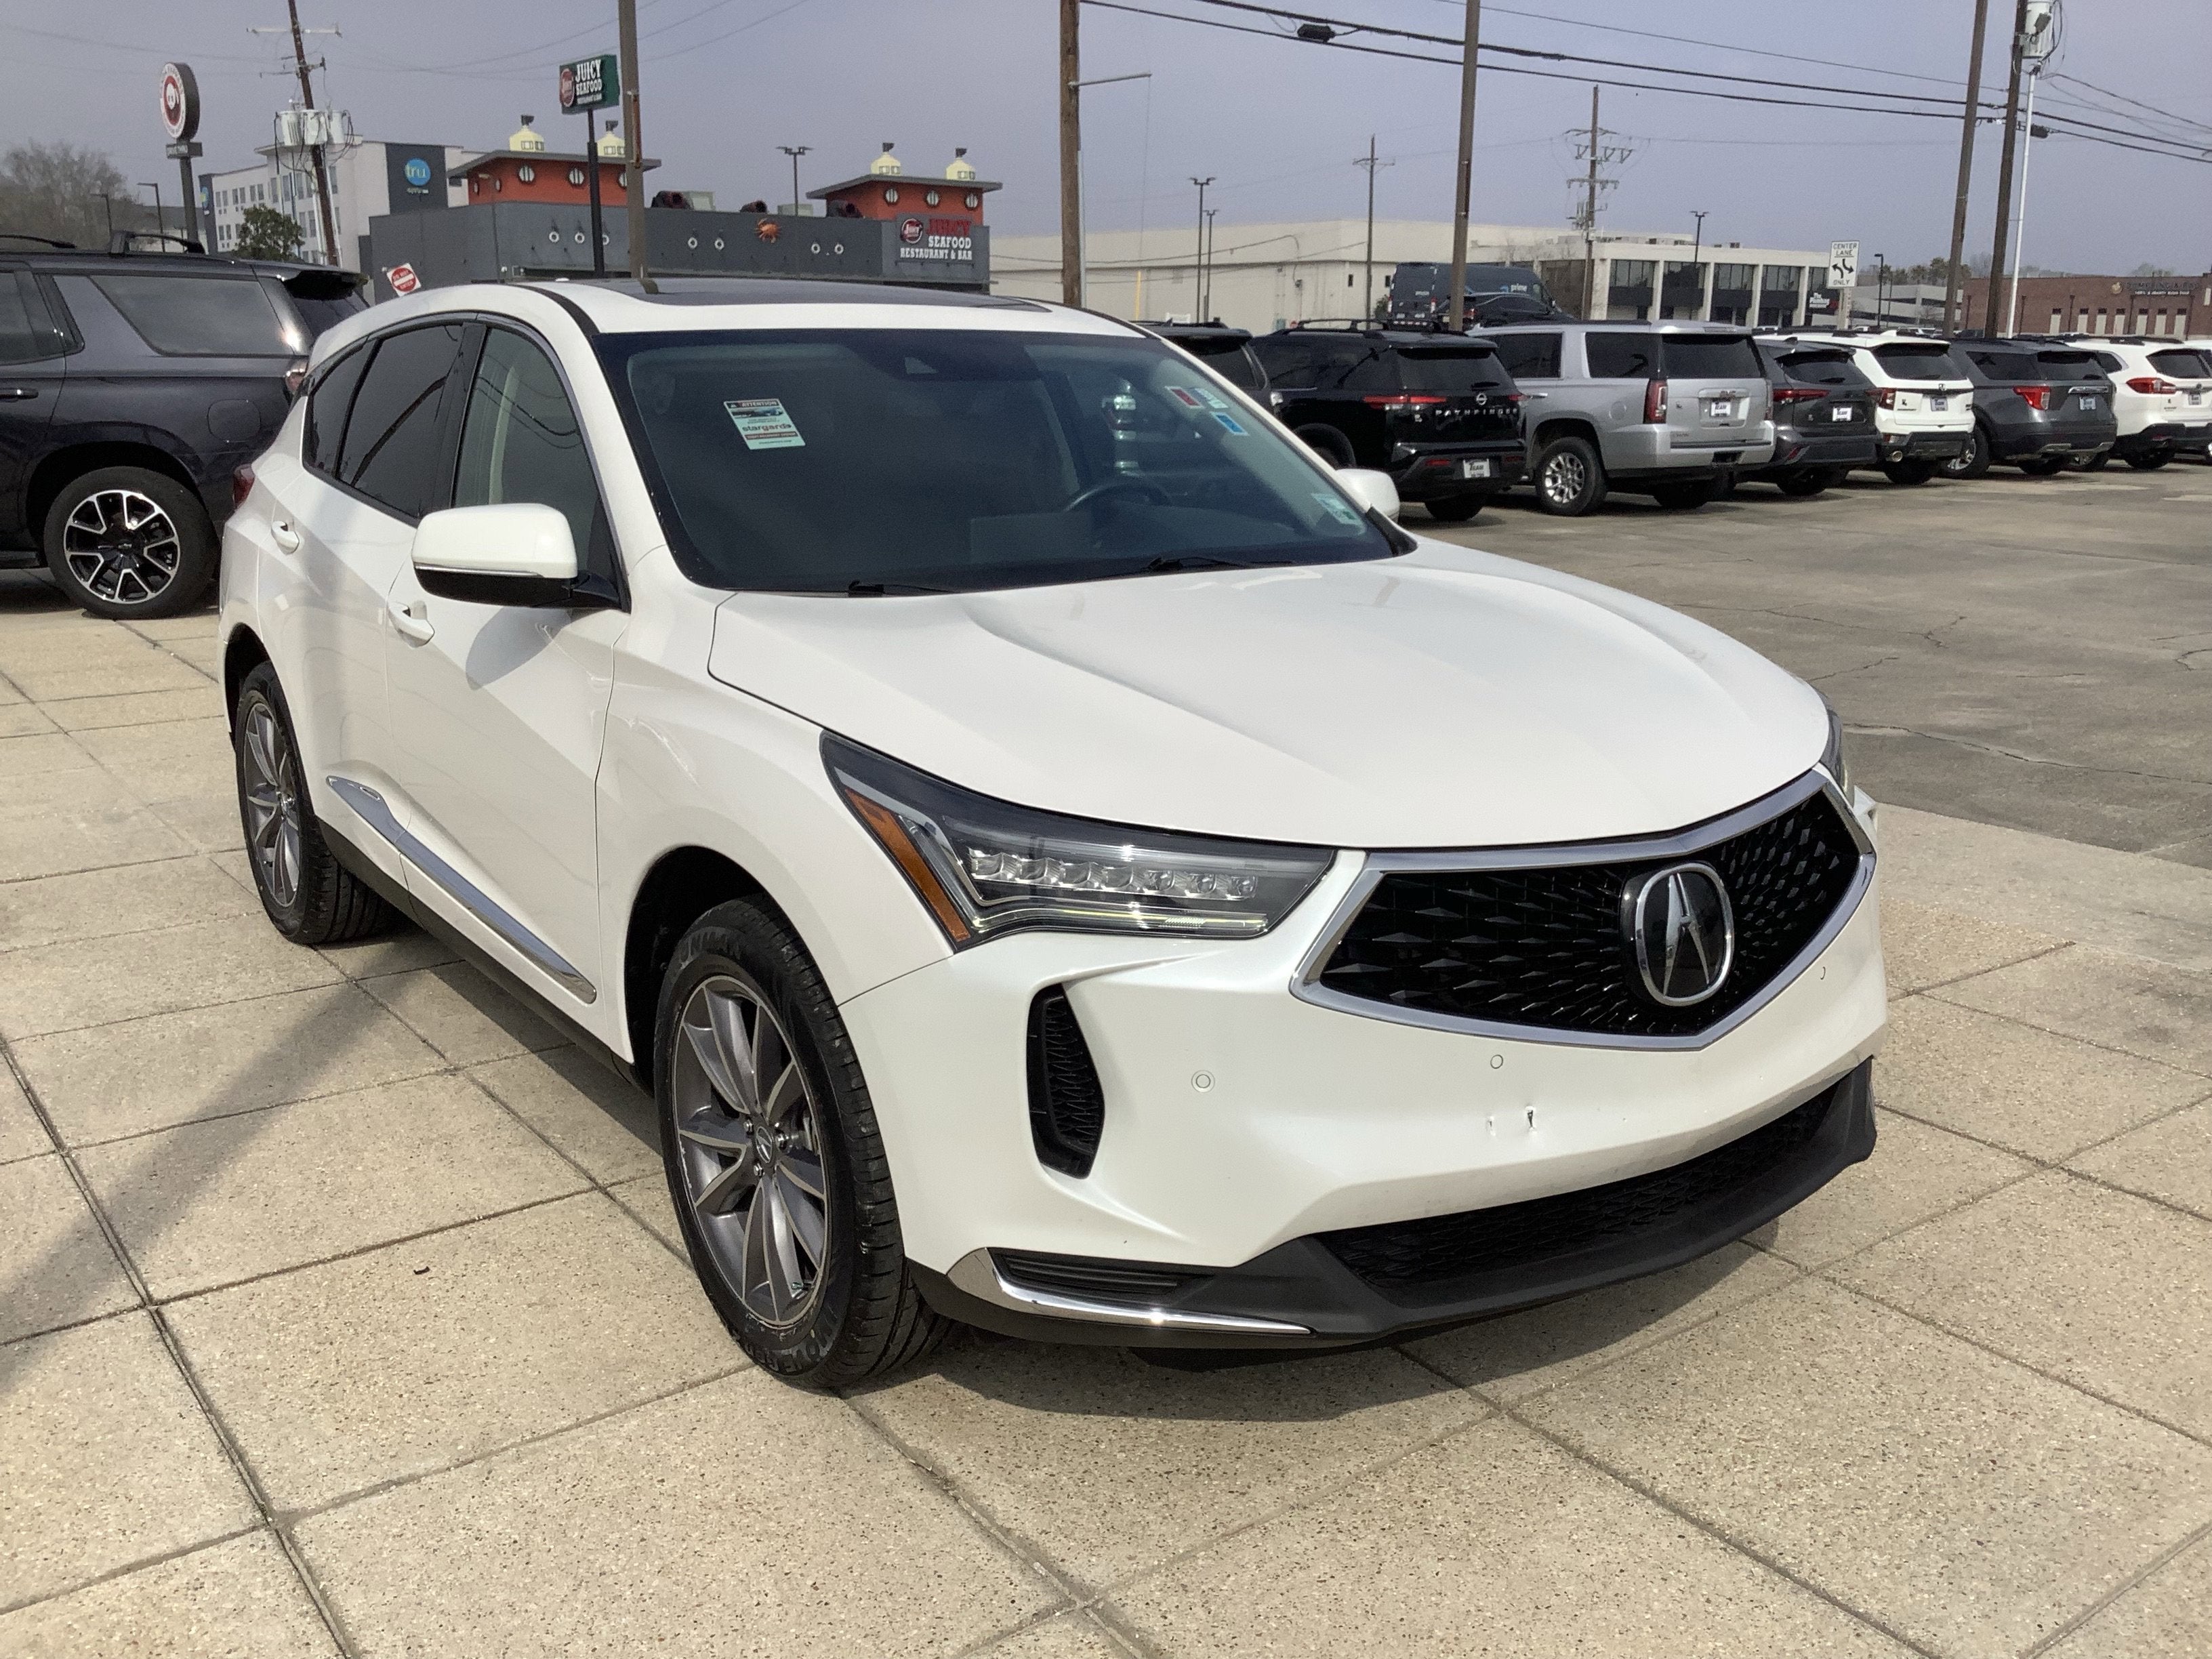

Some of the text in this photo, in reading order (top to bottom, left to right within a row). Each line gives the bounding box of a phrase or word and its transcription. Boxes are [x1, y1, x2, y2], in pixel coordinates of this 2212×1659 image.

[575, 59, 601, 83] JUICY
[576, 79, 602, 96] SEAFOOD
[928, 236, 972, 249] SEAFOOD
[899, 248, 949, 259] RESTAURANT
[958, 250, 972, 260] BAR
